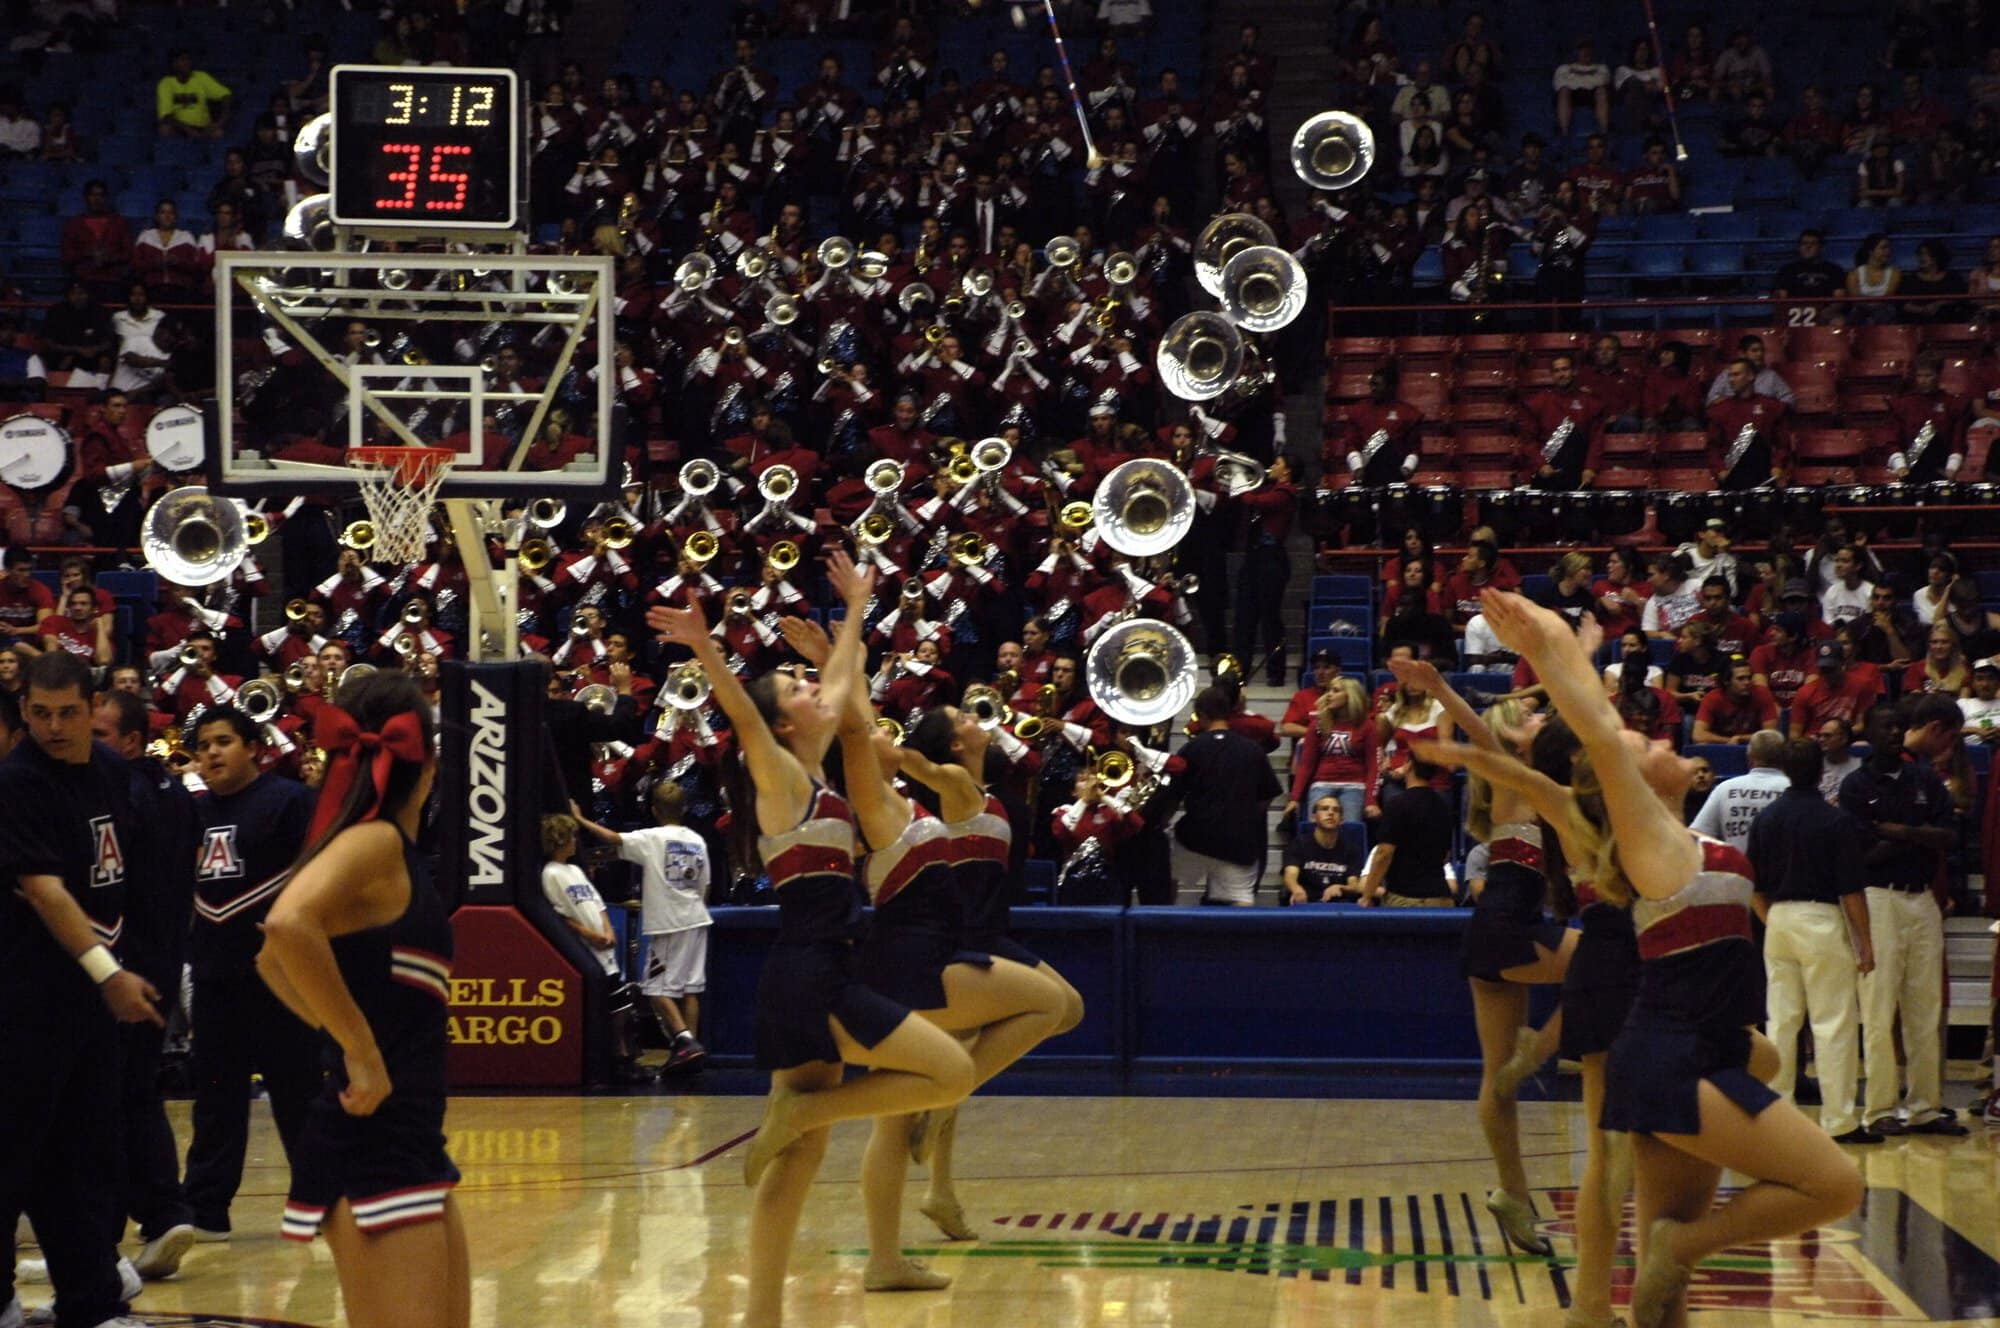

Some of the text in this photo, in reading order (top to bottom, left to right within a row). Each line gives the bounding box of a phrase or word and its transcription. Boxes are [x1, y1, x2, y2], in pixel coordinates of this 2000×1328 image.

[385, 85, 494, 126] 3:12
[375, 144, 472, 210] 35
[1788, 306, 1817, 328] 22
[469, 679, 507, 885] ARIZONA
[1728, 789, 1783, 800] EVENT
[1730, 806, 1762, 817] STA
[1726, 821, 1748, 838] SEC
[88, 814, 125, 888] A
[196, 825, 246, 881] A
[448, 978, 566, 1007] ELLS
[447, 1016, 563, 1044] ARGO
